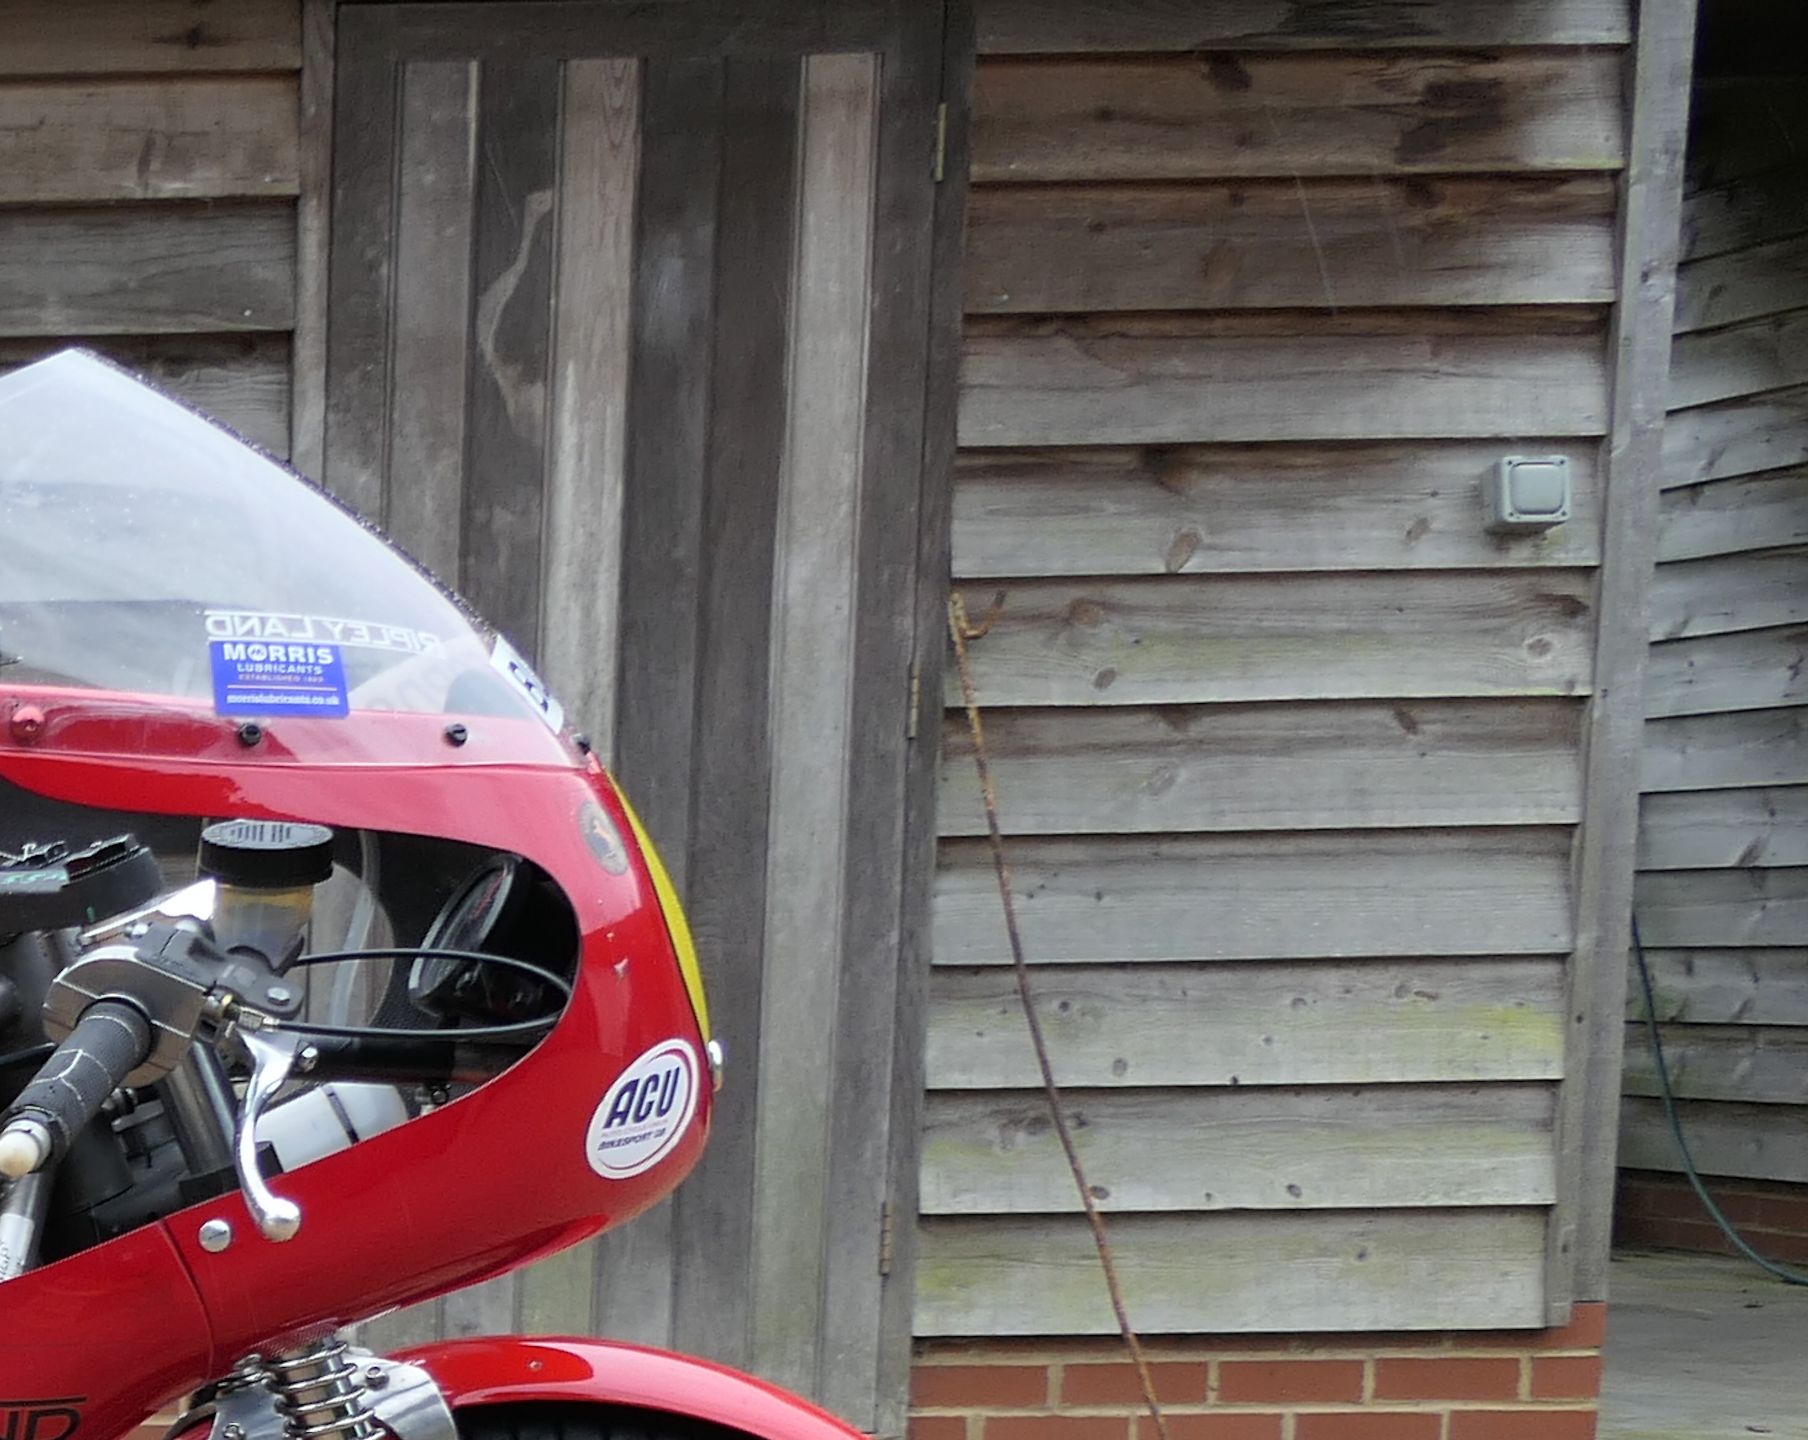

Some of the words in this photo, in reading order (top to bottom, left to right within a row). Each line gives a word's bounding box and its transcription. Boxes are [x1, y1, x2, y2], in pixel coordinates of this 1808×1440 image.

[223, 643, 334, 664] MORRIS
[237, 663, 324, 675] LUBRICANTS
[603, 1066, 681, 1129] ACU
